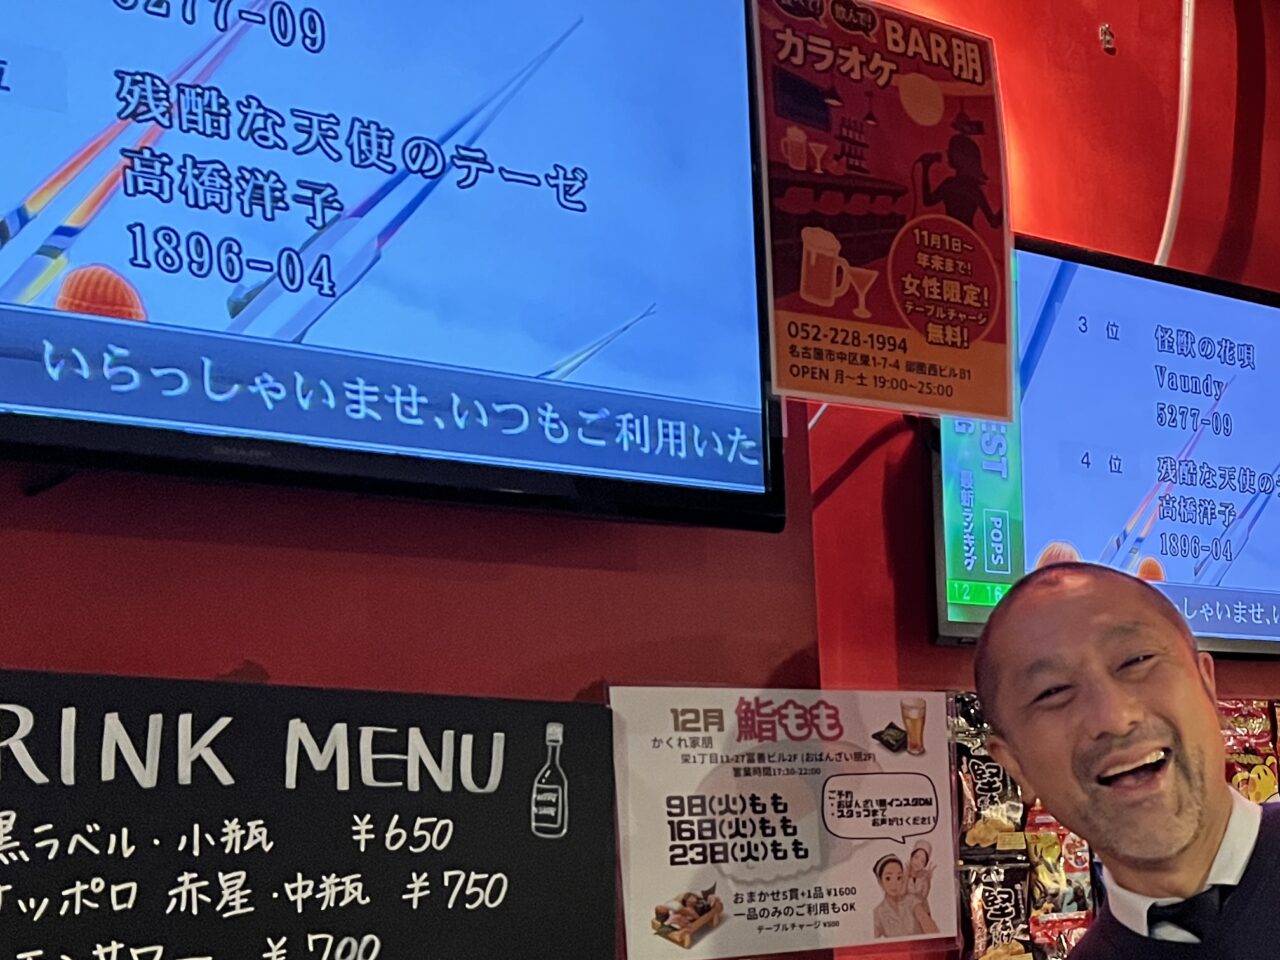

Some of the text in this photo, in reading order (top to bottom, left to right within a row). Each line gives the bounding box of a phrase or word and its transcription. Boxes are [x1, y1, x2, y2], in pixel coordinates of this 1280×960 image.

[112, 0, 325, 53] 77-09
[775, 28, 897, 87] カラオケ
[115, 69, 590, 213] 残酷な天使のテーゼ
[120, 147, 344, 230] 高橋洋子
[127, 222, 336, 297] 1896-04
[787, 320, 908, 354] 052-228-1994
[1078, 316, 1120, 341] 3 位
[1154, 324, 1256, 370] 怪獣の花唄
[789, 364, 829, 382] OPEN
[1154, 365, 1225, 400] Vaundy
[1156, 403, 1233, 437] 5277-09
[1081, 452, 1123, 474] 4 位
[1158, 494, 1237, 528] 高橋洋子
[991, 516, 1004, 566] POPS
[1159, 532, 1233, 562] 1896-04
[671, 708, 725, 733] 12月
[735, 696, 844, 743] 鮨もも
[285, 718, 505, 793] MENU
[651, 736, 714, 750] かくれ家朋
[733, 902, 857, 920] 一品のみのご利用もOK
[757, 921, 821, 934] テーブルチャージ
